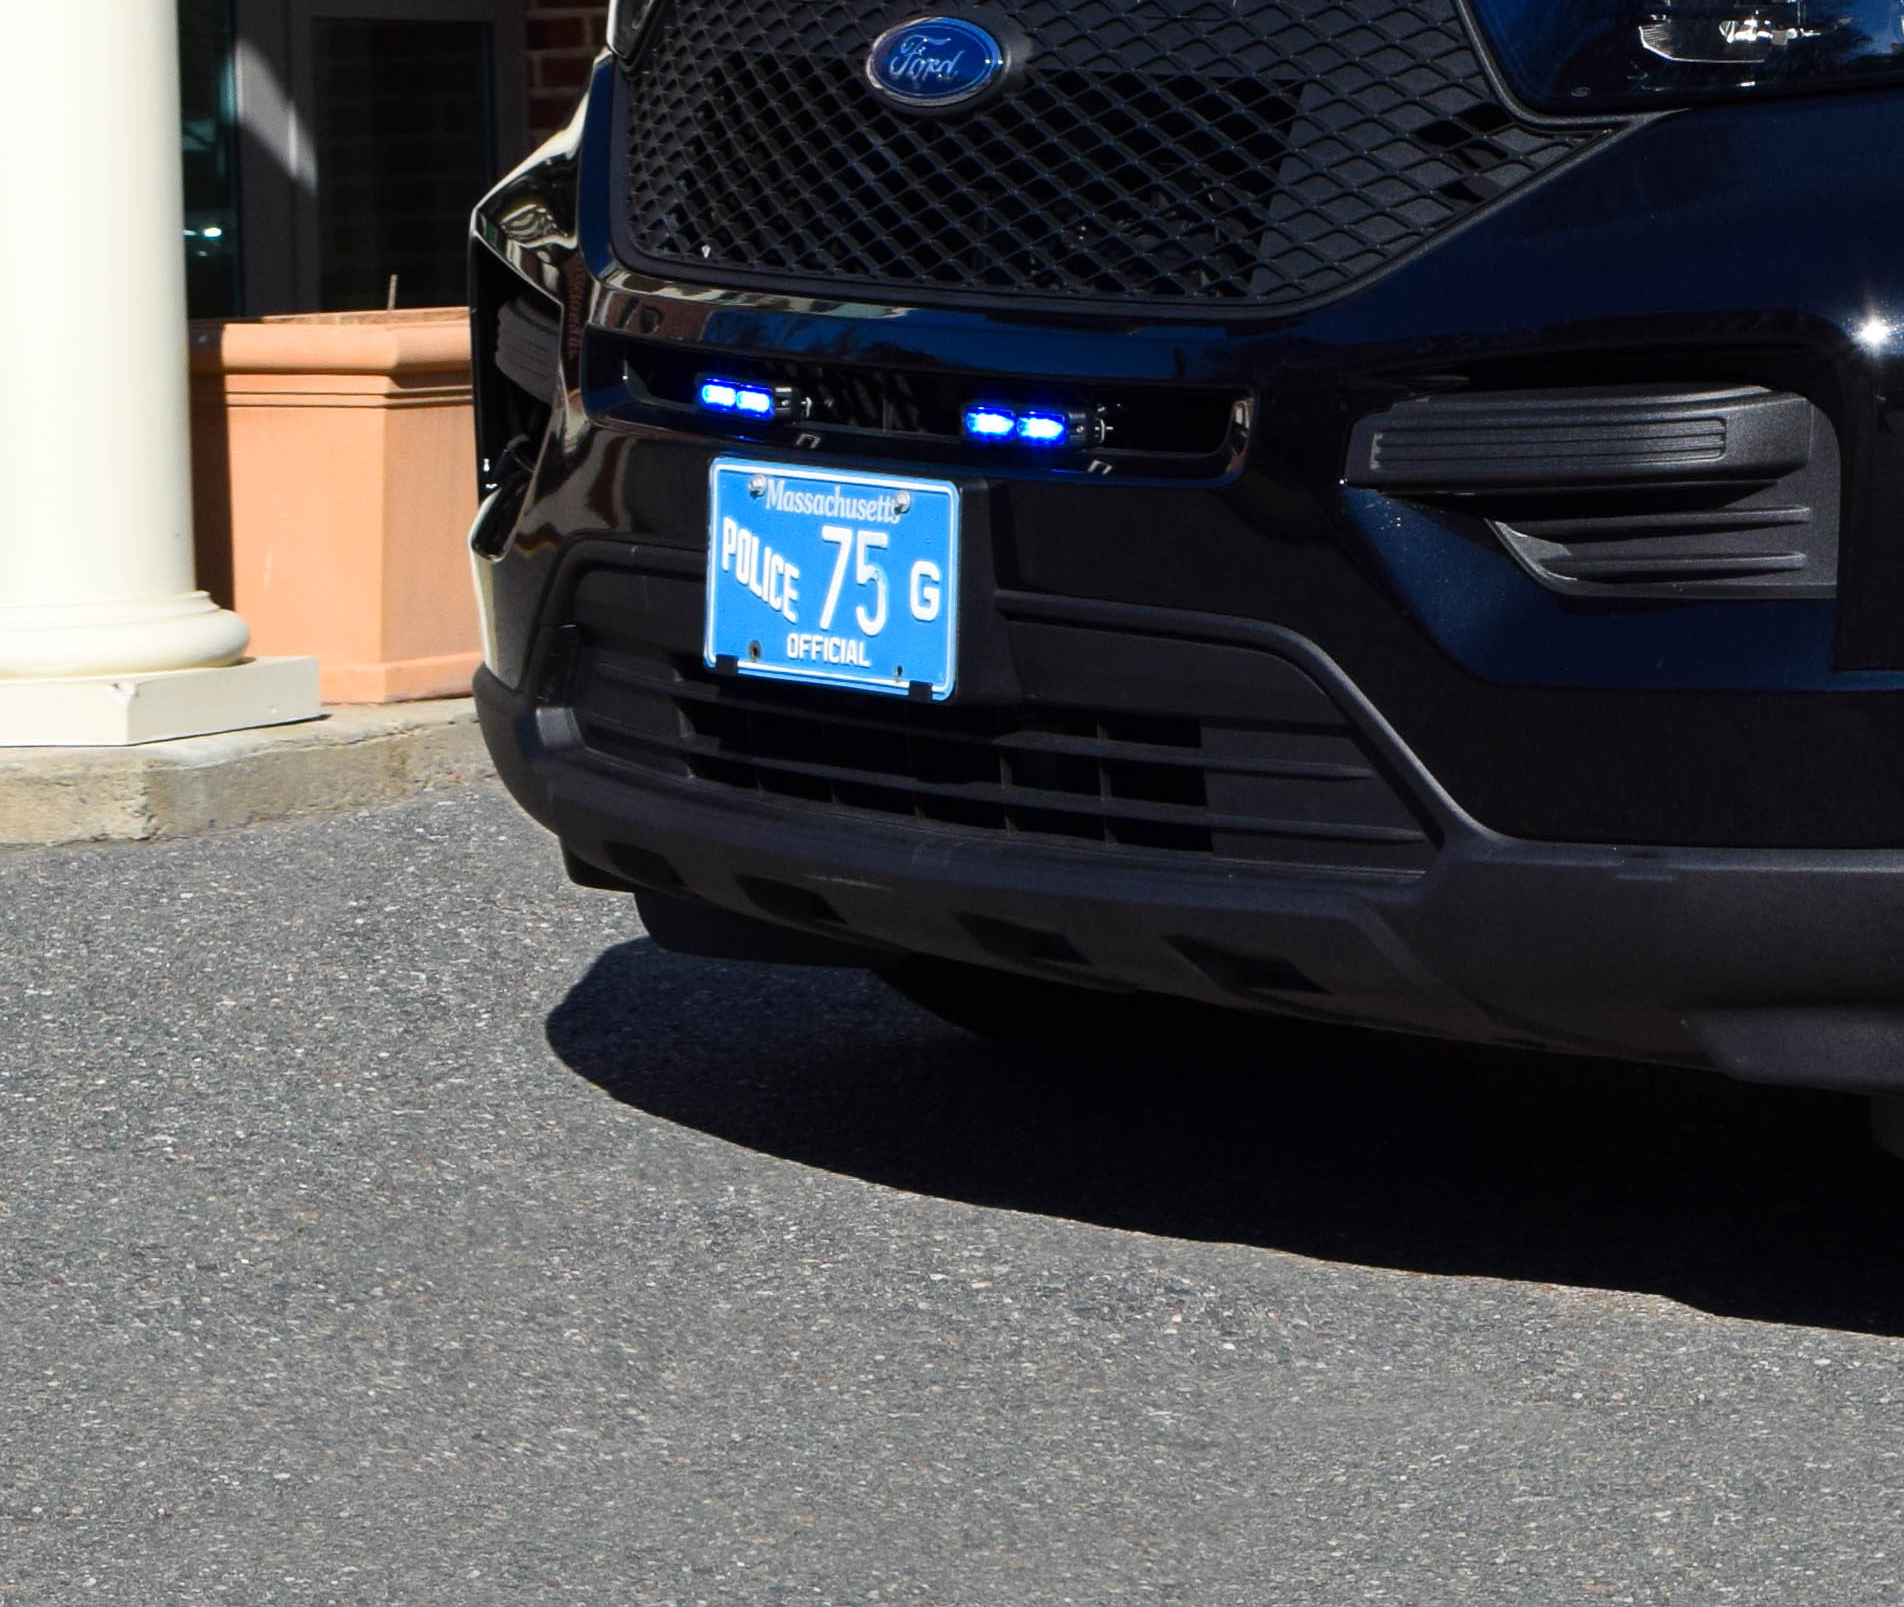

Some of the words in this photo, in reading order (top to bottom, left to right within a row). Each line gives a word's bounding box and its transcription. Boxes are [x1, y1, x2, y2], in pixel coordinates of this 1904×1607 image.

[889, 34, 966, 81] Ford
[765, 478, 900, 524] Massachusetts
[722, 516, 799, 624] POLICE
[819, 525, 889, 637] 75
[909, 560, 941, 622] G
[787, 633, 871, 668] OFFICIAL
